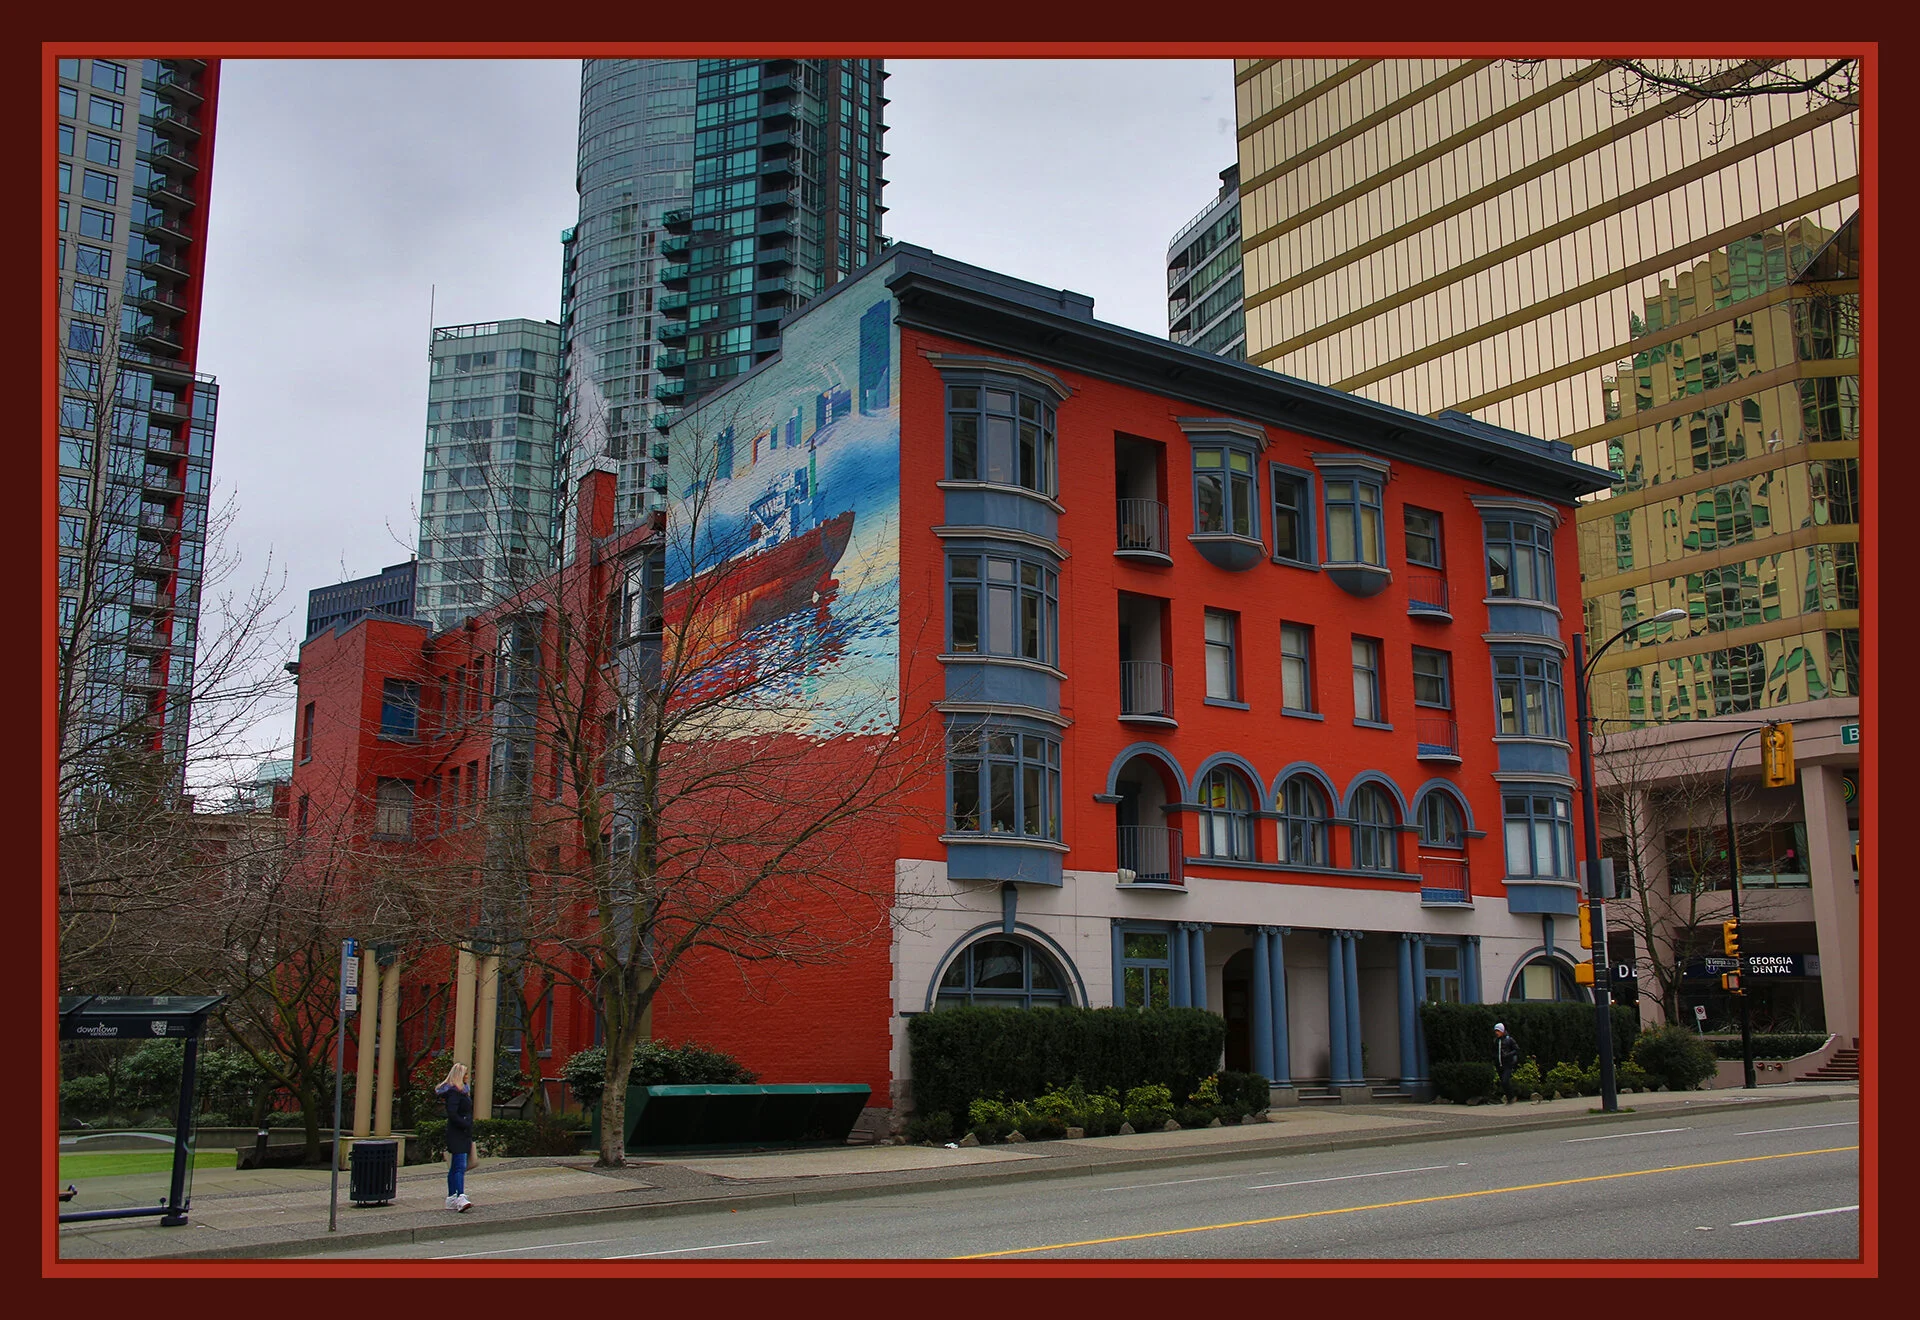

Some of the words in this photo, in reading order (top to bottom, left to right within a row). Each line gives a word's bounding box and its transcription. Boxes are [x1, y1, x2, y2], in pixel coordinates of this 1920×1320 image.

[1749, 956, 1793, 965] GEORGIA
[1752, 965, 1791, 974] DENTAL
[77, 1023, 118, 1034] downtown
